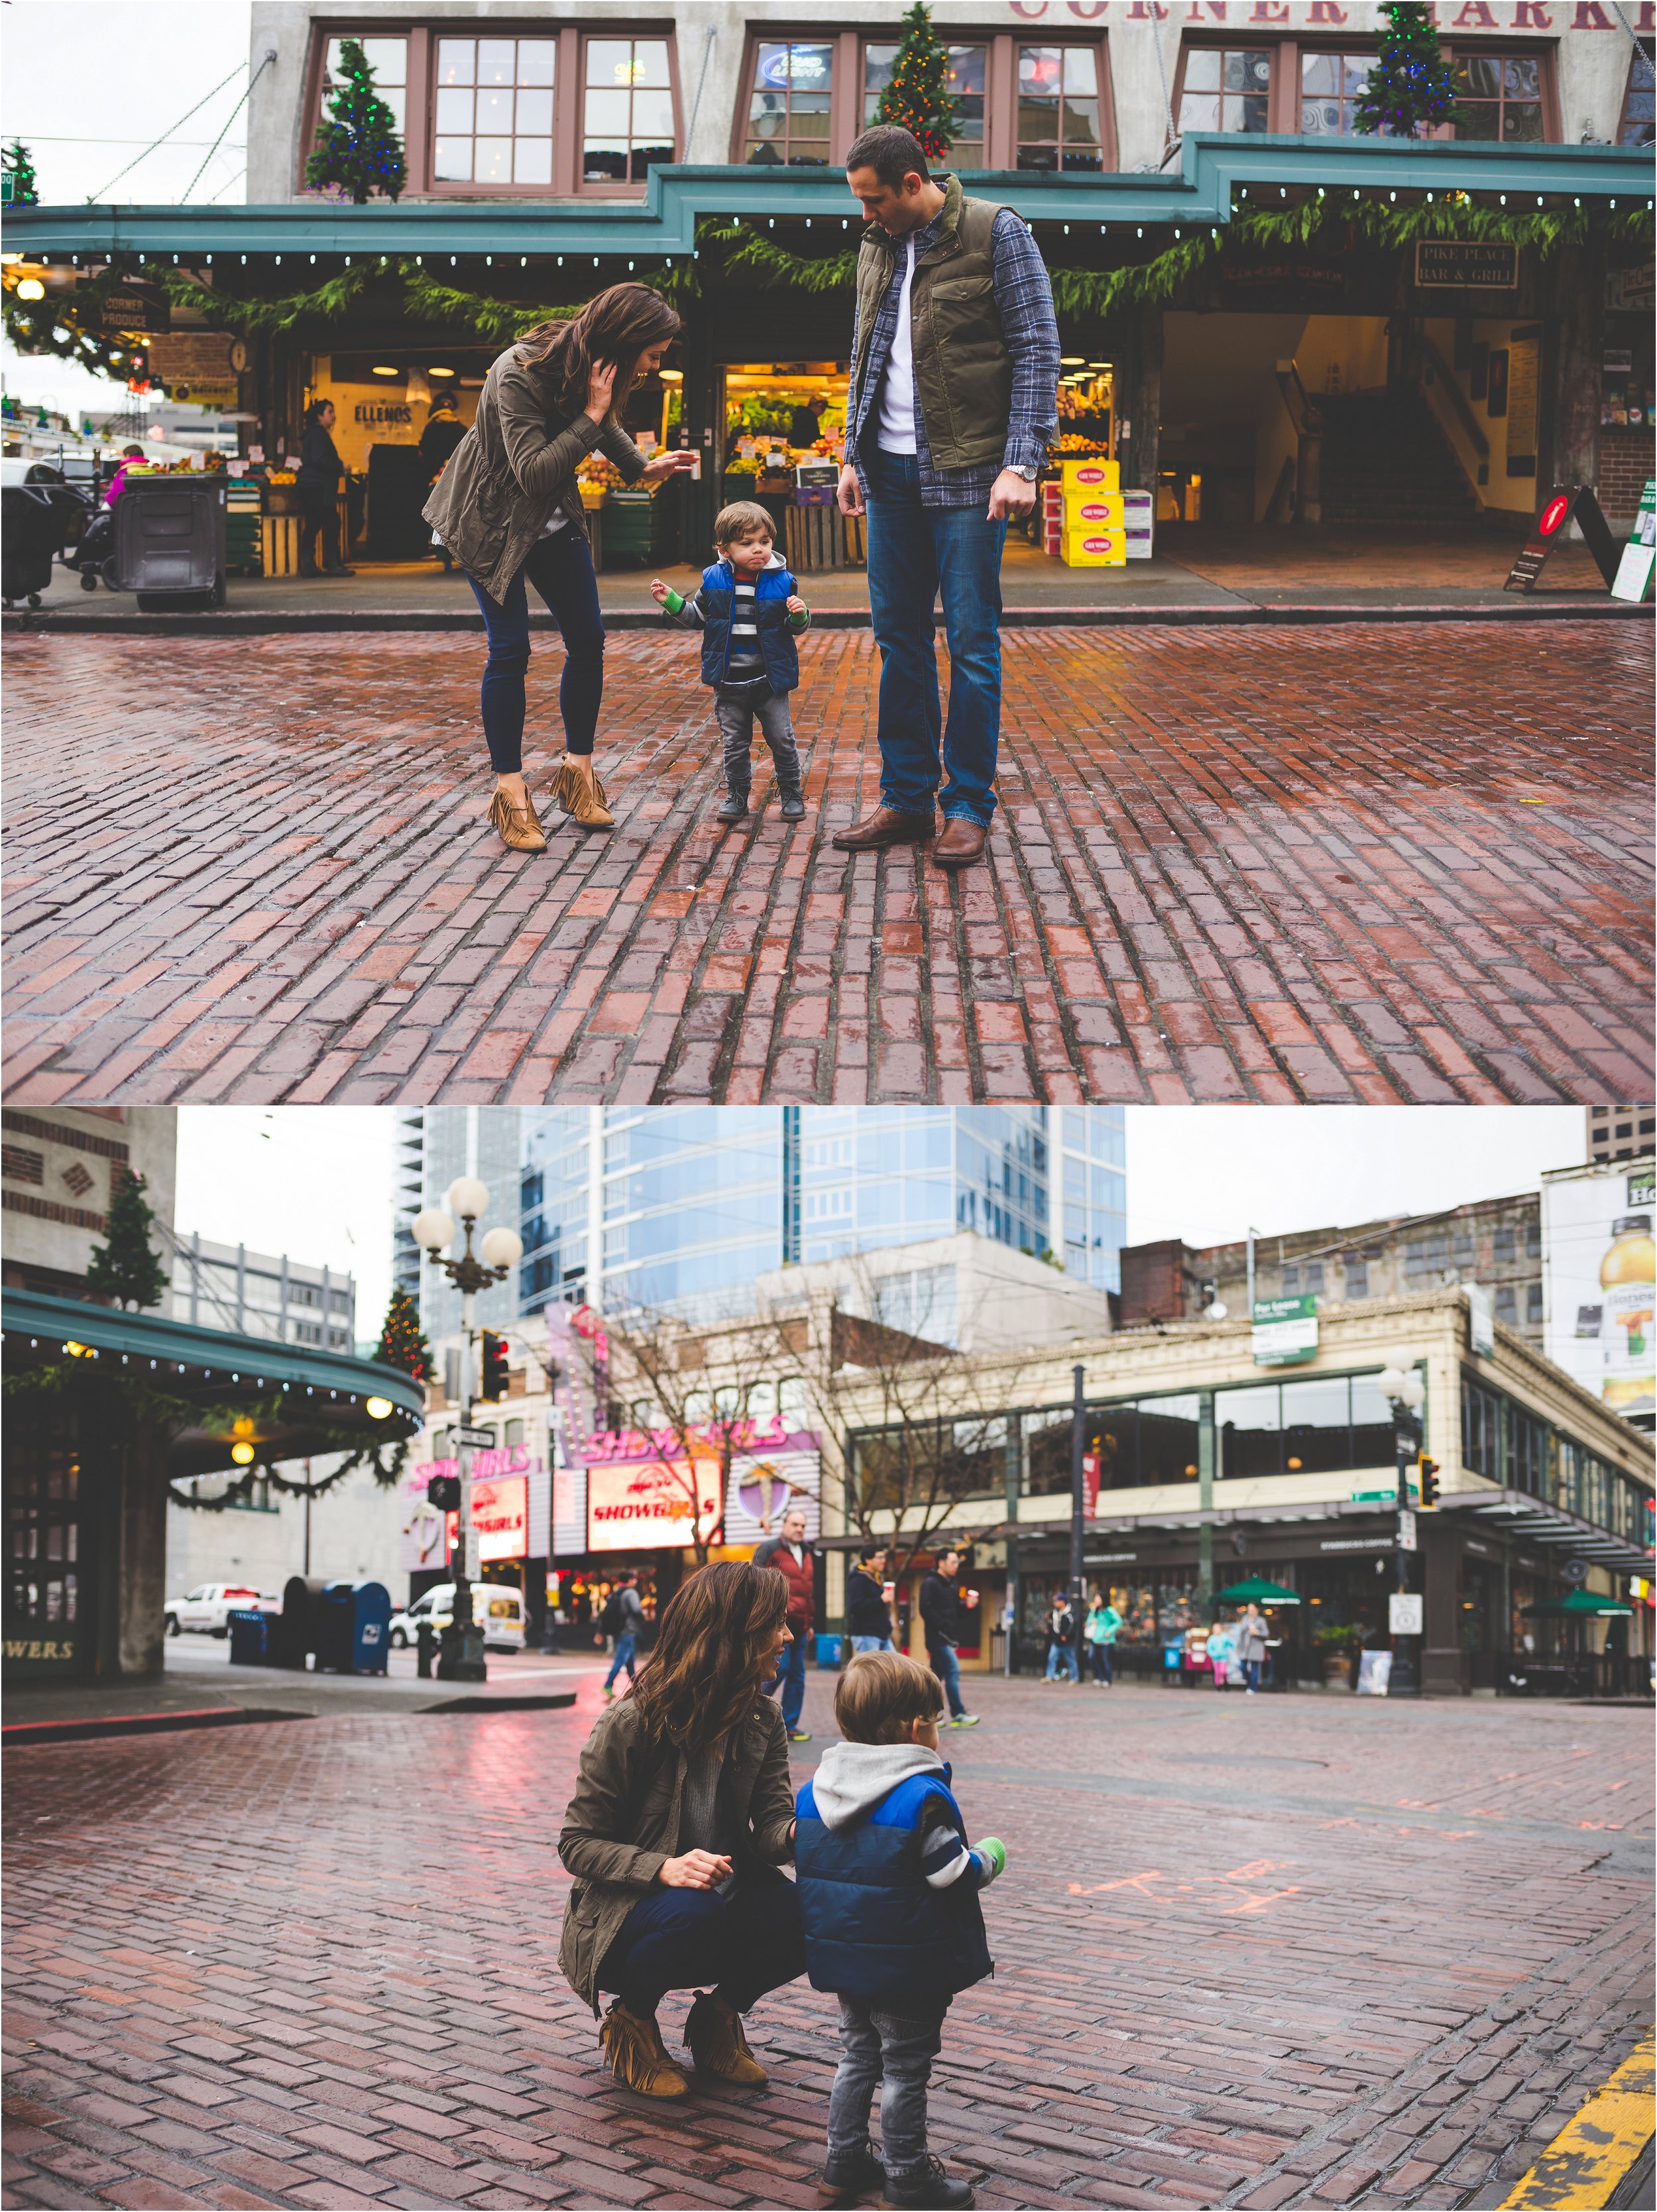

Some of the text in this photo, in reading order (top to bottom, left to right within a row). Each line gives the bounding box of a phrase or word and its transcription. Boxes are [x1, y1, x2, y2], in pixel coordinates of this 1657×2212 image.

[1424, 247, 1510, 261] PIKE PLACE
[1420, 268, 1512, 282] BAR & GRILL
[106, 298, 144, 311] CORNER
[101, 312, 146, 327] PRODUCE
[1255, 1303, 1271, 1313] For
[1, 1639, 74, 1659] WERS
